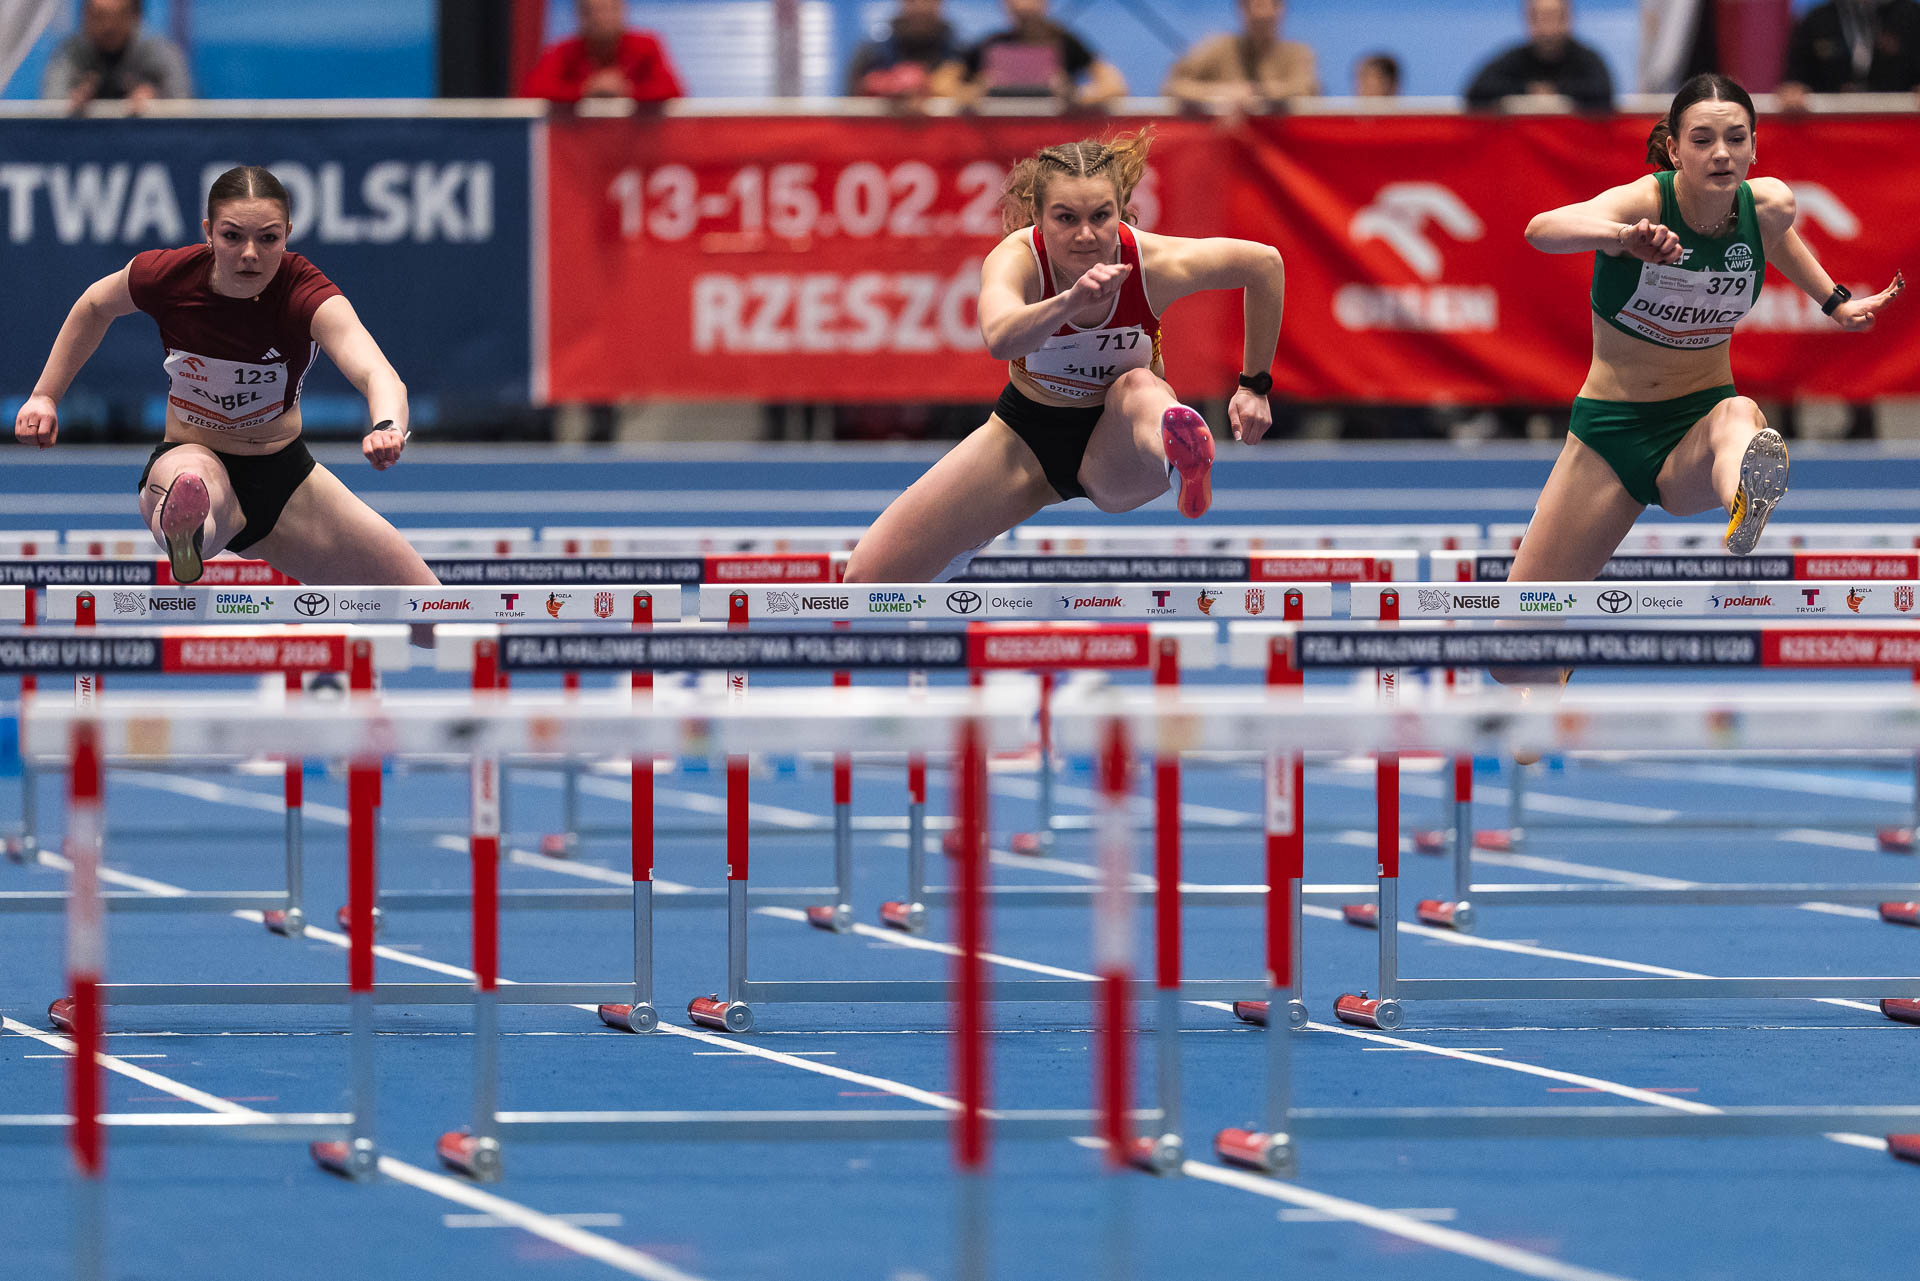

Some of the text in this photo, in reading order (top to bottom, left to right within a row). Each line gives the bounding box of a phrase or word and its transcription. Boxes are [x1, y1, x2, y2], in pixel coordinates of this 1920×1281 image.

[202, 160, 495, 243] OLSKI
[1731, 247, 1747, 256] AZS
[1730, 260, 1749, 269] AWF
[1706, 277, 1747, 296] 379
[693, 257, 986, 354] RZESZÓ
[1632, 298, 1745, 324] DUSIEWICZ
[1096, 331, 1140, 351] 717
[1686, 337, 1709, 345] 2026
[178, 371, 208, 382] ORLEN
[234, 368, 277, 385] 123
[1063, 363, 1116, 379] ŻUK
[189, 384, 263, 411] ZUBEL
[240, 417, 264, 428] 2026
[37, 565, 85, 582] POLSKI
[1676, 560, 1724, 577] POLSKI
[216, 594, 253, 604] GRUPA
[869, 593, 905, 603] GRUPA
[1074, 596, 1123, 609] polanik
[1520, 592, 1556, 602] GRUPA
[1642, 597, 1683, 610] Okęcie
[1723, 595, 1773, 609] polanik
[216, 604, 260, 614] LUXMED
[339, 600, 381, 613] Okęcie
[421, 598, 472, 612] polanik
[869, 603, 912, 613] LUXMED
[992, 598, 1033, 610] Okęcie
[1520, 602, 1563, 612] LUXMED
